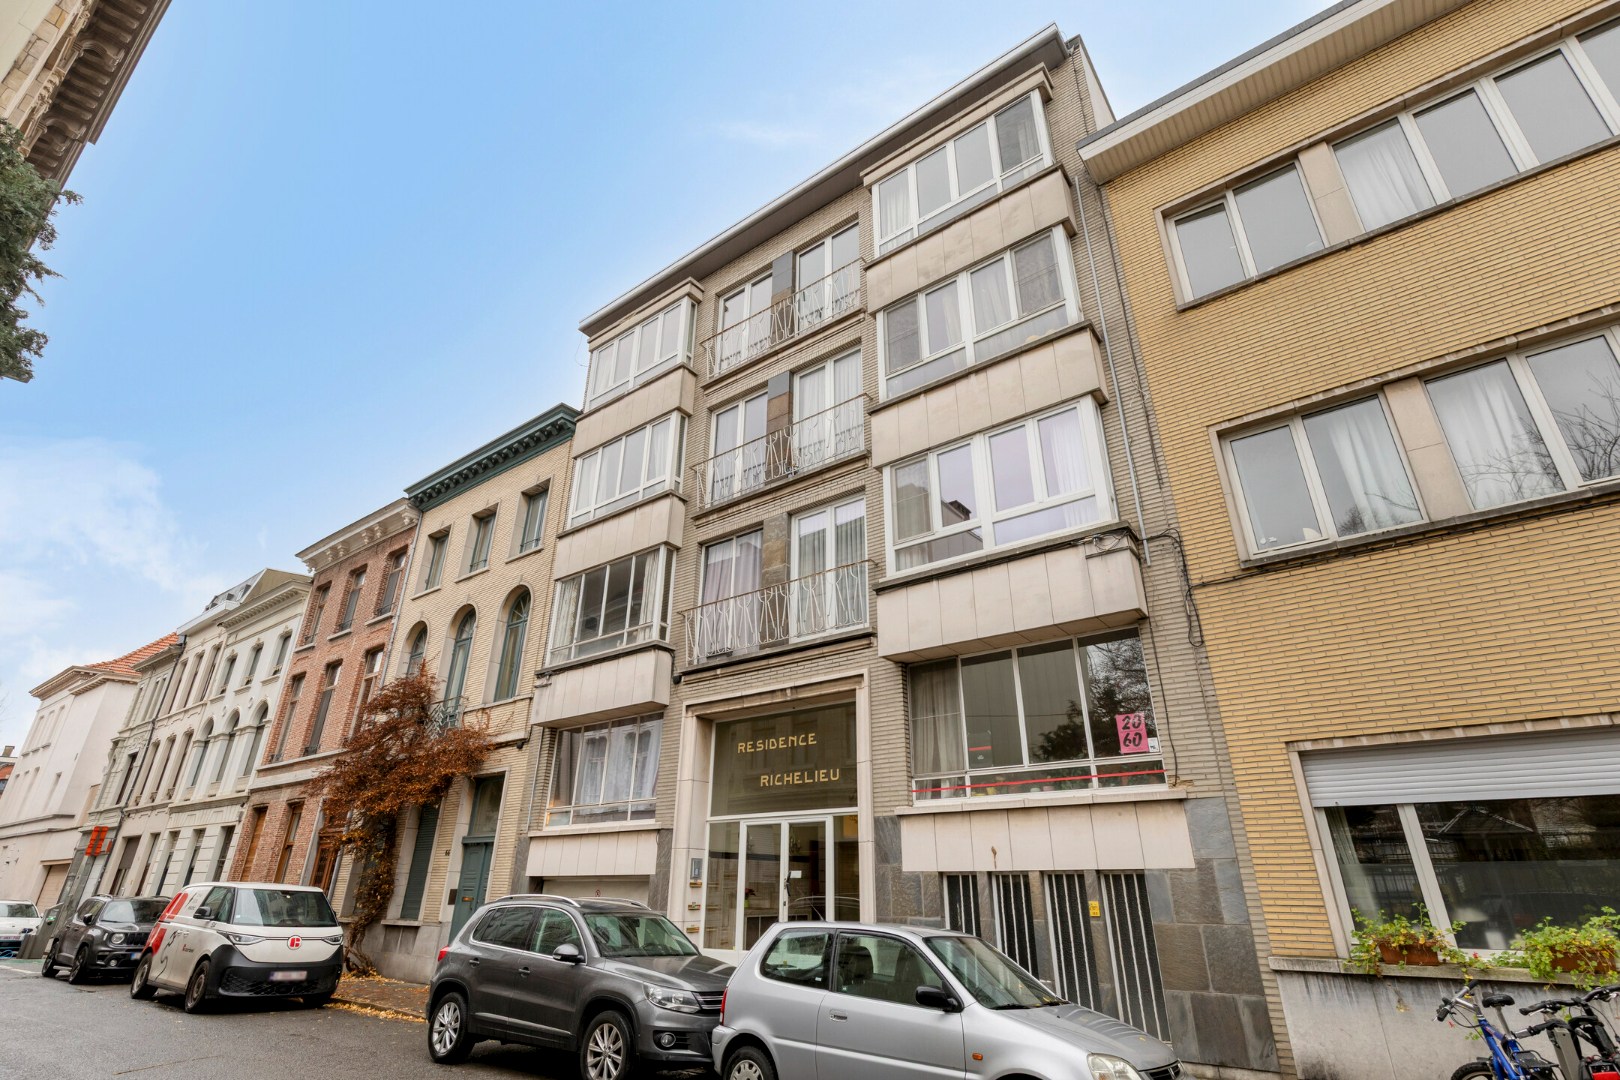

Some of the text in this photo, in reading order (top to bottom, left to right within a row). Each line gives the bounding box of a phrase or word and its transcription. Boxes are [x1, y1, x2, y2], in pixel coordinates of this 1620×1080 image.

[1122, 714, 1142, 730] 20
[737, 733, 817, 753] RESIDENCE
[1123, 732, 1142, 747] 60
[760, 768, 840, 787] RICHELIEU
